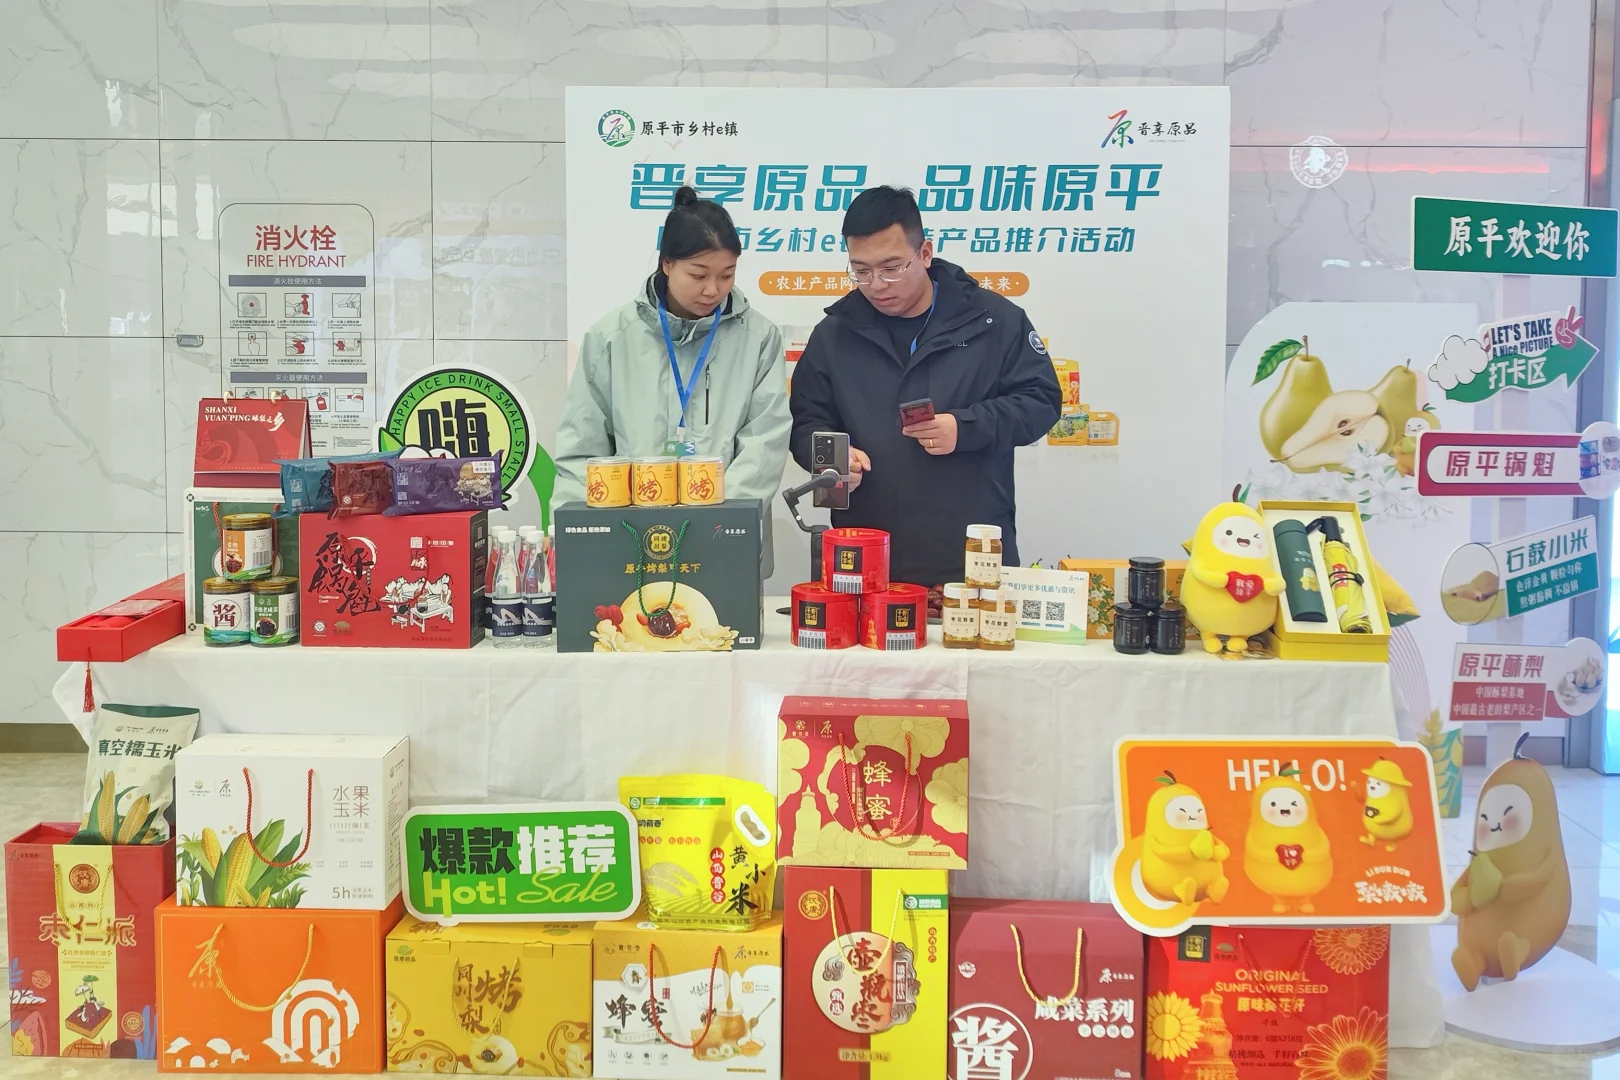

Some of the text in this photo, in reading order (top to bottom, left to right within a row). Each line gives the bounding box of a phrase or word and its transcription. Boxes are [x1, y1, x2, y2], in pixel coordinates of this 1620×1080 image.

[639, 120, 739, 137] 原平市乡村e镇
[1137, 121, 1197, 137] 晋享原品
[630, 163, 1163, 212] 晋享原品 品味原平
[255, 224, 337, 252] 消火栓
[1443, 215, 1591, 262] 原平欢迎你
[246, 254, 346, 268] FIRE HYDRANT
[273, 277, 323, 286] 消火栓使用方法
[1490, 317, 1553, 346] LET'S TAKE
[1492, 346, 1499, 359] A
[1519, 336, 1554, 355] PICTURE
[275, 374, 324, 383] 灭火器使用方法
[1488, 356, 1547, 390] 打卡区
[392, 374, 526, 481] HAPPY ICE DRINK SMALL STALL
[417, 398, 493, 458] 嗨
[1445, 450, 1556, 477] 原平锅魁
[588, 480, 605, 502] 烤
[638, 479, 658, 500] 烤
[690, 478, 711, 500] 烤
[1506, 527, 1588, 574] 石鼓小米
[1516, 561, 1583, 593] 色泽金黄 颗粒匀称
[213, 604, 237, 628] 酱
[1458, 652, 1545, 679] 原平酥梨
[1475, 685, 1525, 699] 中国酥梨基地
[1452, 702, 1543, 717] 中国最古老的梨产区之一
[98, 739, 182, 761] 真空糯玉米
[332, 785, 370, 801] 水果
[862, 760, 893, 821] 蜂蜜
[332, 801, 370, 818] 玉米
[419, 824, 617, 876] 爆款 推荐
[332, 886, 351, 899] 5h
[422, 865, 618, 919] Hot! Sale
[725, 844, 767, 916] 黄小米
[1215, 982, 1329, 994] SUNFLOWER SEED
[1235, 968, 1311, 983] ORIGINAL
[605, 994, 668, 1029] 蜂蜜
[1035, 995, 1135, 1024] 咸菜系列
[951, 1016, 1020, 1080] 酱
